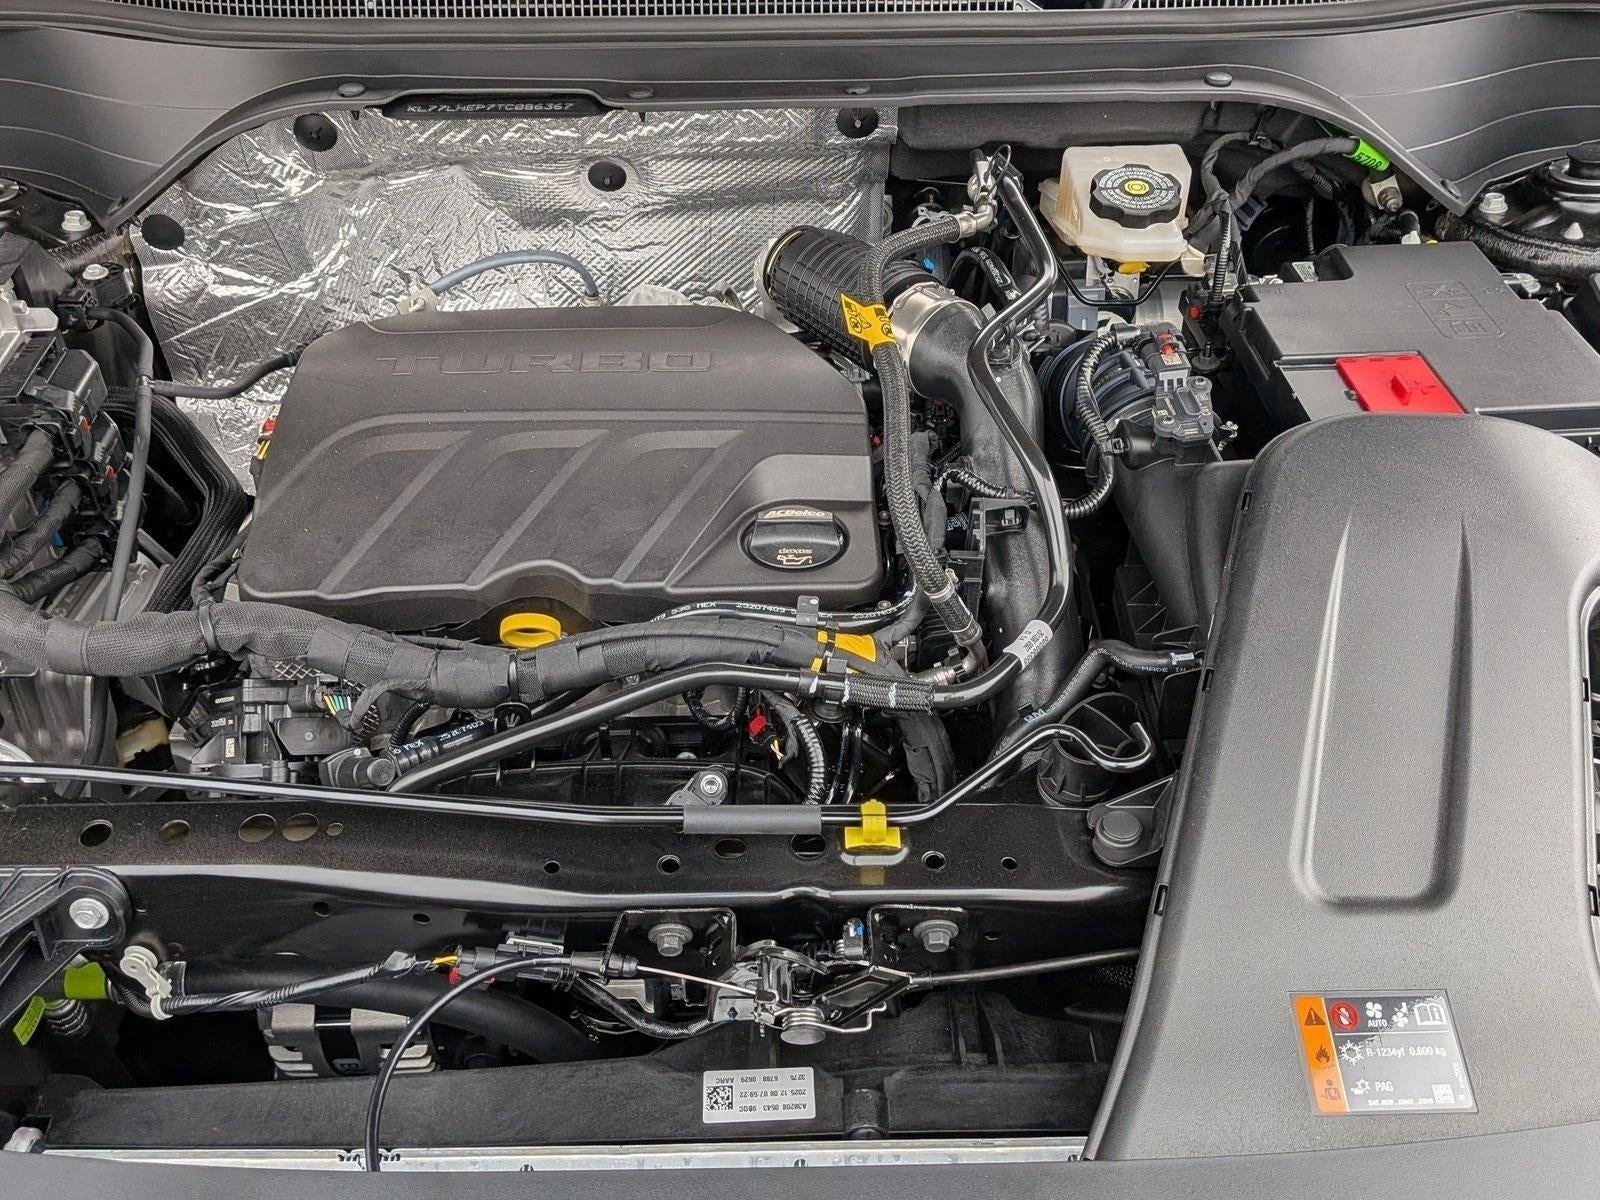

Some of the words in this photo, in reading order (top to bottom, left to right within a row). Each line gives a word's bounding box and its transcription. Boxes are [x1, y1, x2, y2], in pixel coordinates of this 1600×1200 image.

[406, 102, 574, 113] KL77LHEP7TC086367
[375, 350, 714, 376] TURBO
[763, 509, 826, 519] ACDelco
[1367, 1019, 1388, 1028] AUTO
[1366, 1047, 1406, 1059] R-1234yf
[1435, 1047, 1447, 1058] kg
[1374, 1080, 1394, 1092] PAG
